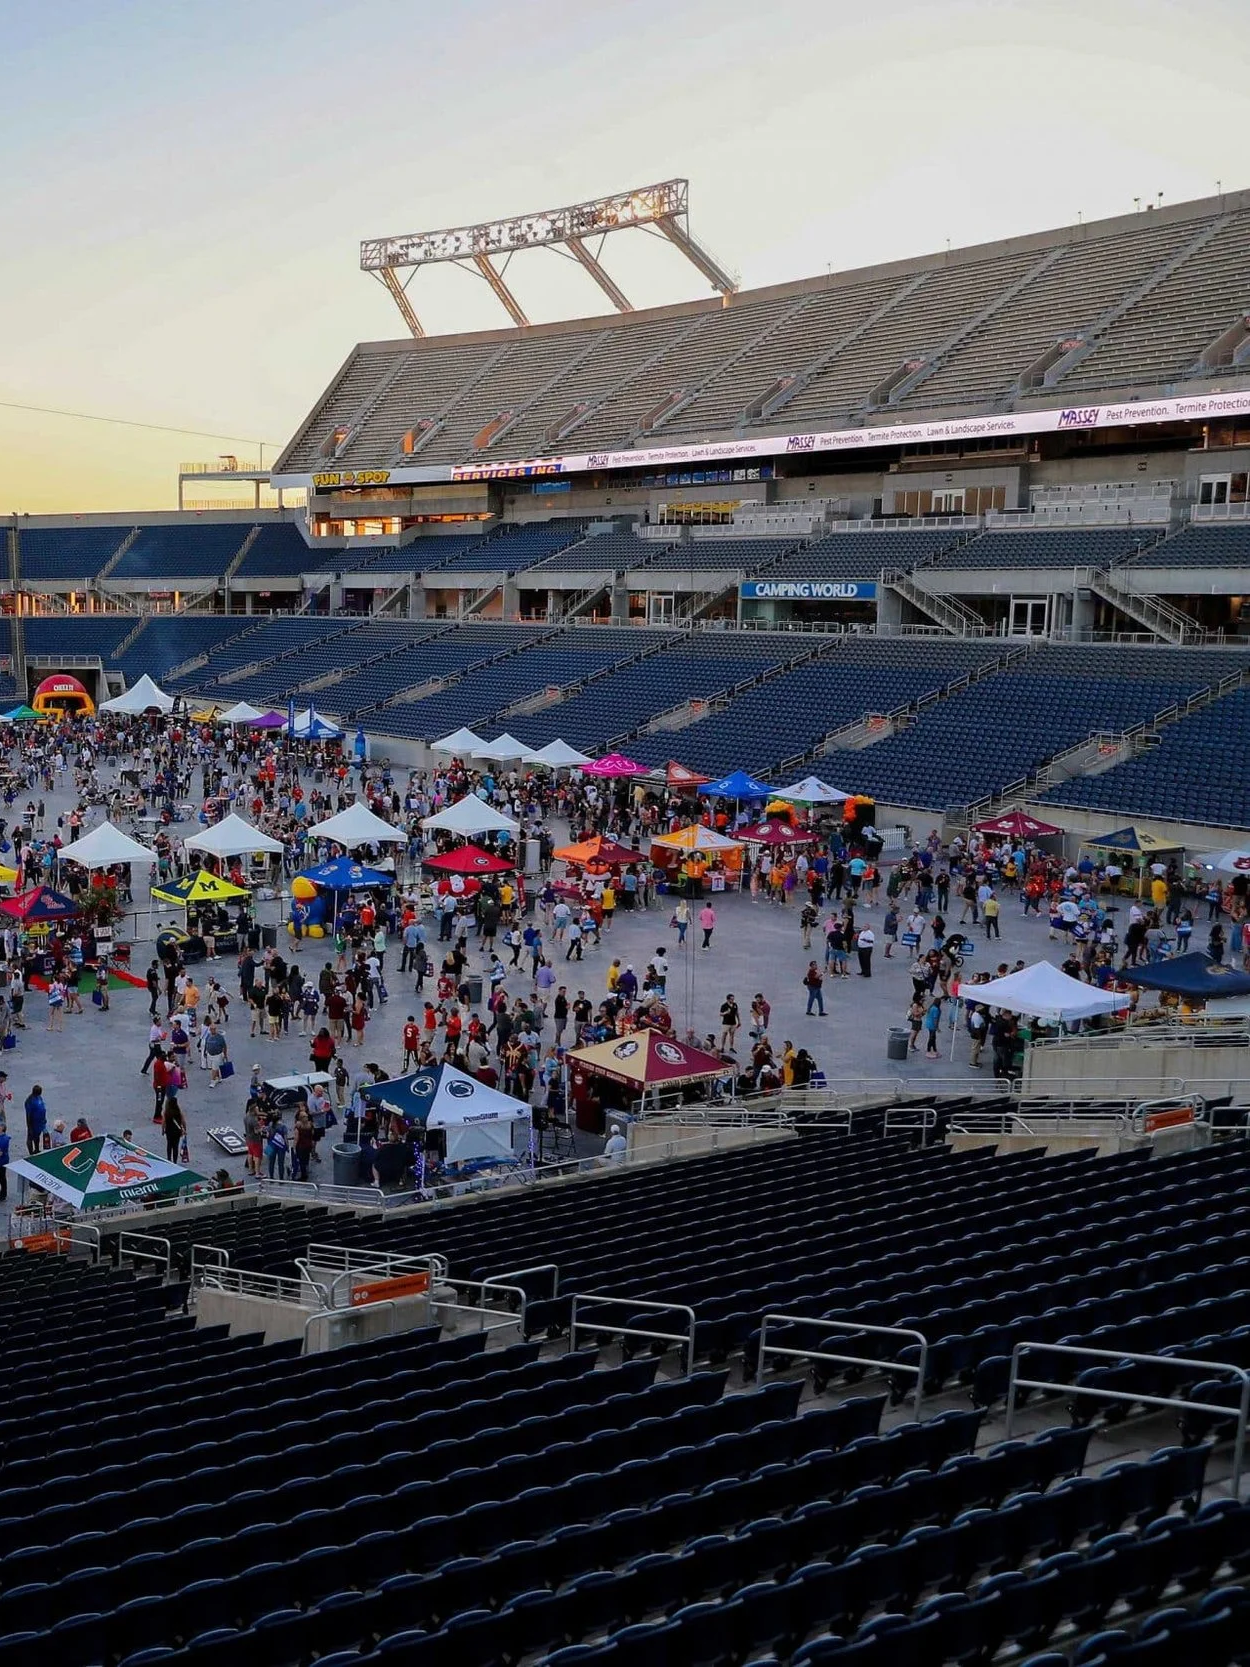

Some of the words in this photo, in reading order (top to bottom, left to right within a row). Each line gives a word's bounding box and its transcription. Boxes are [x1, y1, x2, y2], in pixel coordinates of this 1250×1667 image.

[1058, 409, 1100, 427] MASSEY
[1106, 410, 1123, 420] Pest
[1124, 405, 1169, 418] Prevention.
[1175, 402, 1206, 414] Termite
[786, 436, 815, 450] MASSEY
[927, 426, 944, 436] Lawn
[951, 421, 986, 435] Landscape
[987, 419, 1016, 431] Services.
[587, 454, 608, 467] MASSEY
[313, 473, 340, 486] FUN
[356, 470, 390, 483] SPOT
[453, 467, 525, 481] SERVICES
[531, 464, 561, 476] INC.
[755, 583, 809, 597] CAMPING
[811, 583, 858, 597] WORLD
[199, 881, 219, 892] M
[62, 1147, 94, 1174] U
